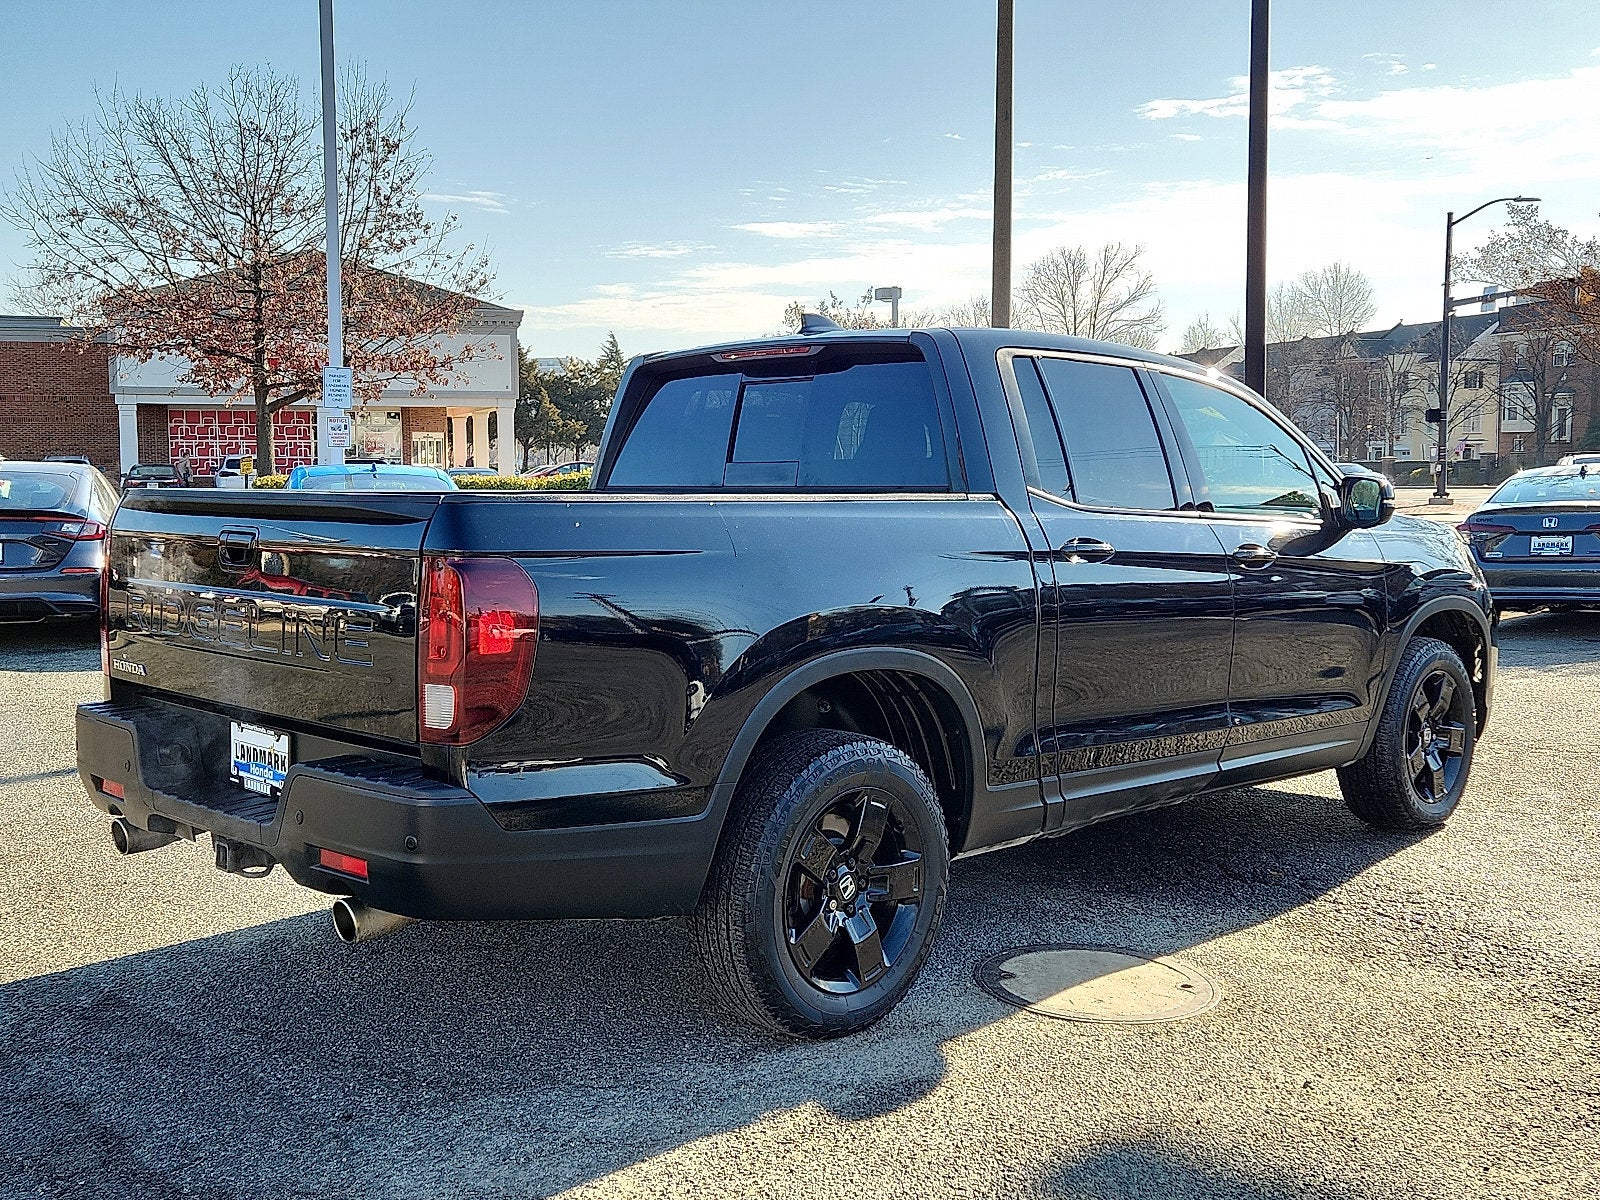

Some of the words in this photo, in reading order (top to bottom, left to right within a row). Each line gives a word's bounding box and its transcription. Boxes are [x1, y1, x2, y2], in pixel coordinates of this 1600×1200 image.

[125, 592, 374, 667] RIDGELINE
[112, 658, 147, 676] HONDA
[234, 741, 287, 773] LANDMARK
[250, 763, 274, 779] Honda
